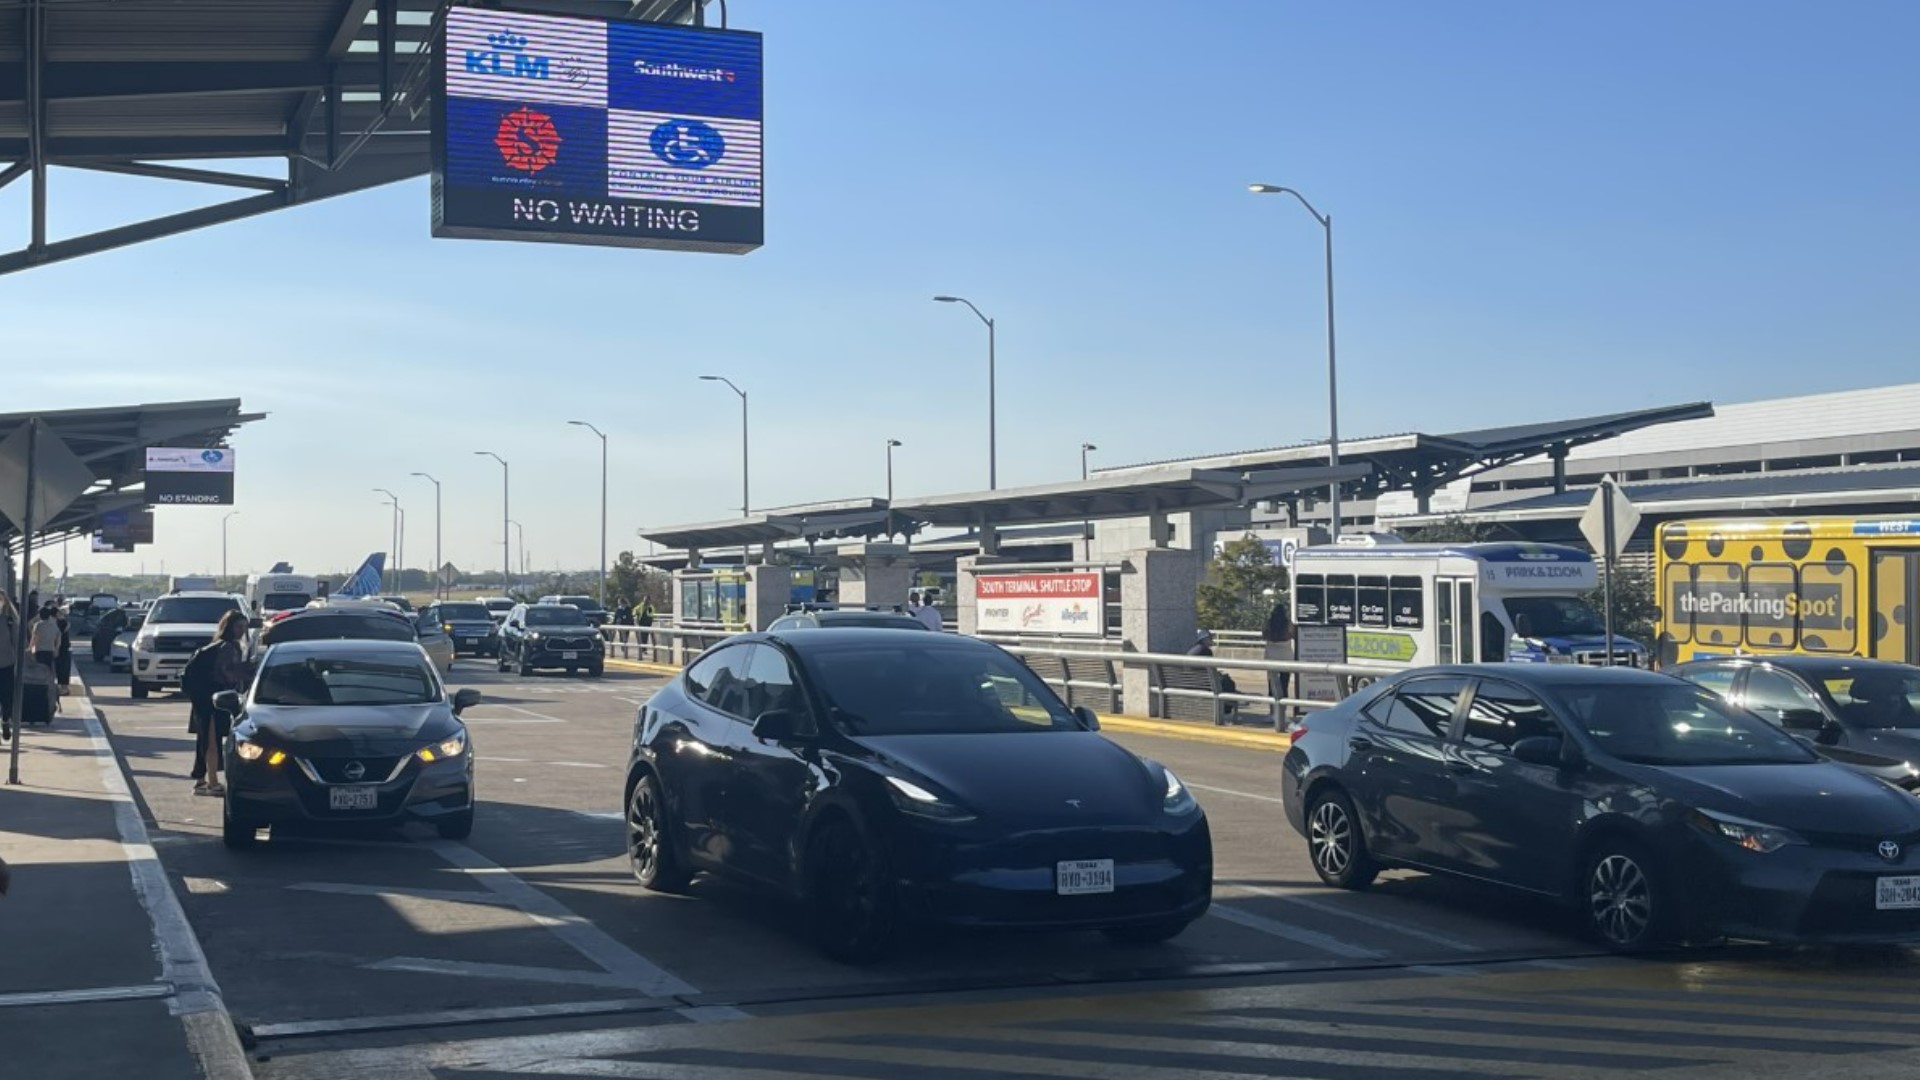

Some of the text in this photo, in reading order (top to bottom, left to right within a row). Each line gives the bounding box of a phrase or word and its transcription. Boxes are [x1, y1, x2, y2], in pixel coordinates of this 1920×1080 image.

[466, 50, 549, 79] KLM
[634, 61, 722, 81] Southwest
[514, 198, 700, 231] NO WAITING
[159, 494, 219, 503] NO STANDING
[1879, 521, 1912, 532] WEST
[982, 579, 1092, 594] SOUTH TERMINAL SHUTTLE STOP
[1680, 591, 1836, 620] theParkingSpot
